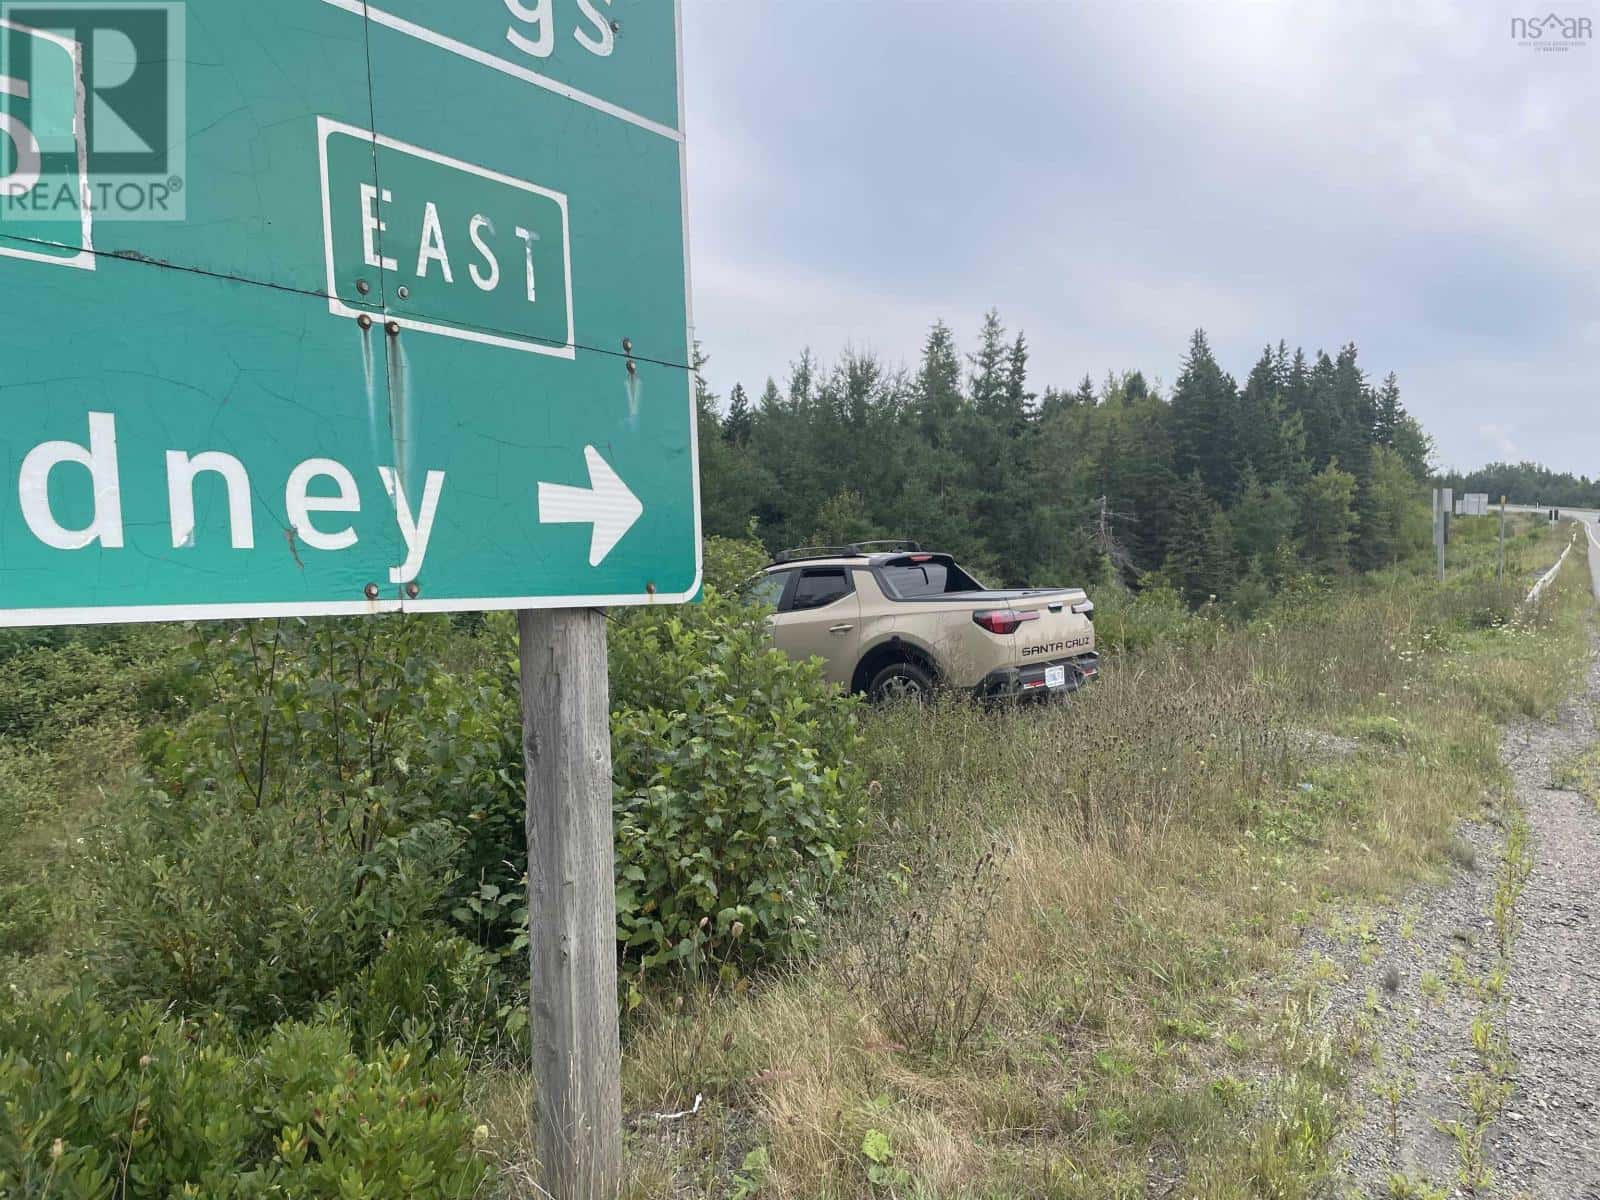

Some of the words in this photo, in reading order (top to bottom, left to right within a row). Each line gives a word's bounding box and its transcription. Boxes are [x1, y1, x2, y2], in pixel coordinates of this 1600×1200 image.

[360, 182, 540, 302] EAST
[18, 411, 446, 583] dney
[1022, 642, 1063, 656] SANTA
